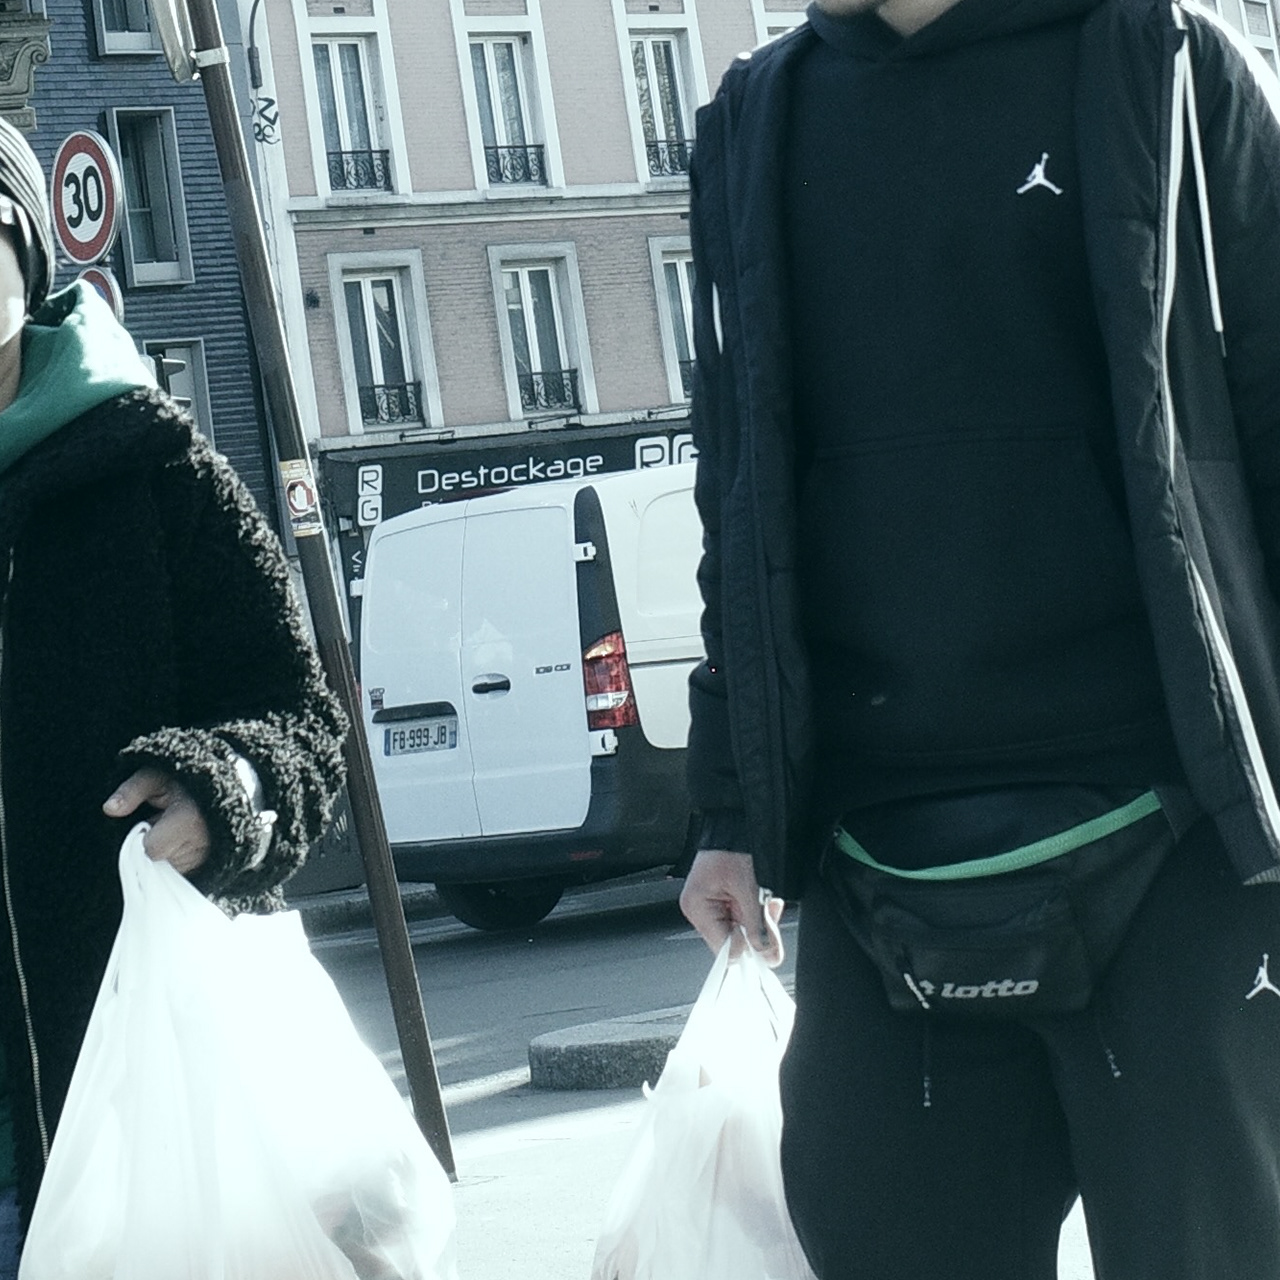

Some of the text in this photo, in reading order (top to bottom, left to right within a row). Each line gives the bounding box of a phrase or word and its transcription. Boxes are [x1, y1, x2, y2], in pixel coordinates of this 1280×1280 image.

[64, 165, 103, 229] 30
[418, 454, 603, 494] Destockage
[392, 725, 447, 750] FB-999-JB
[941, 978, 1039, 998] lotto
